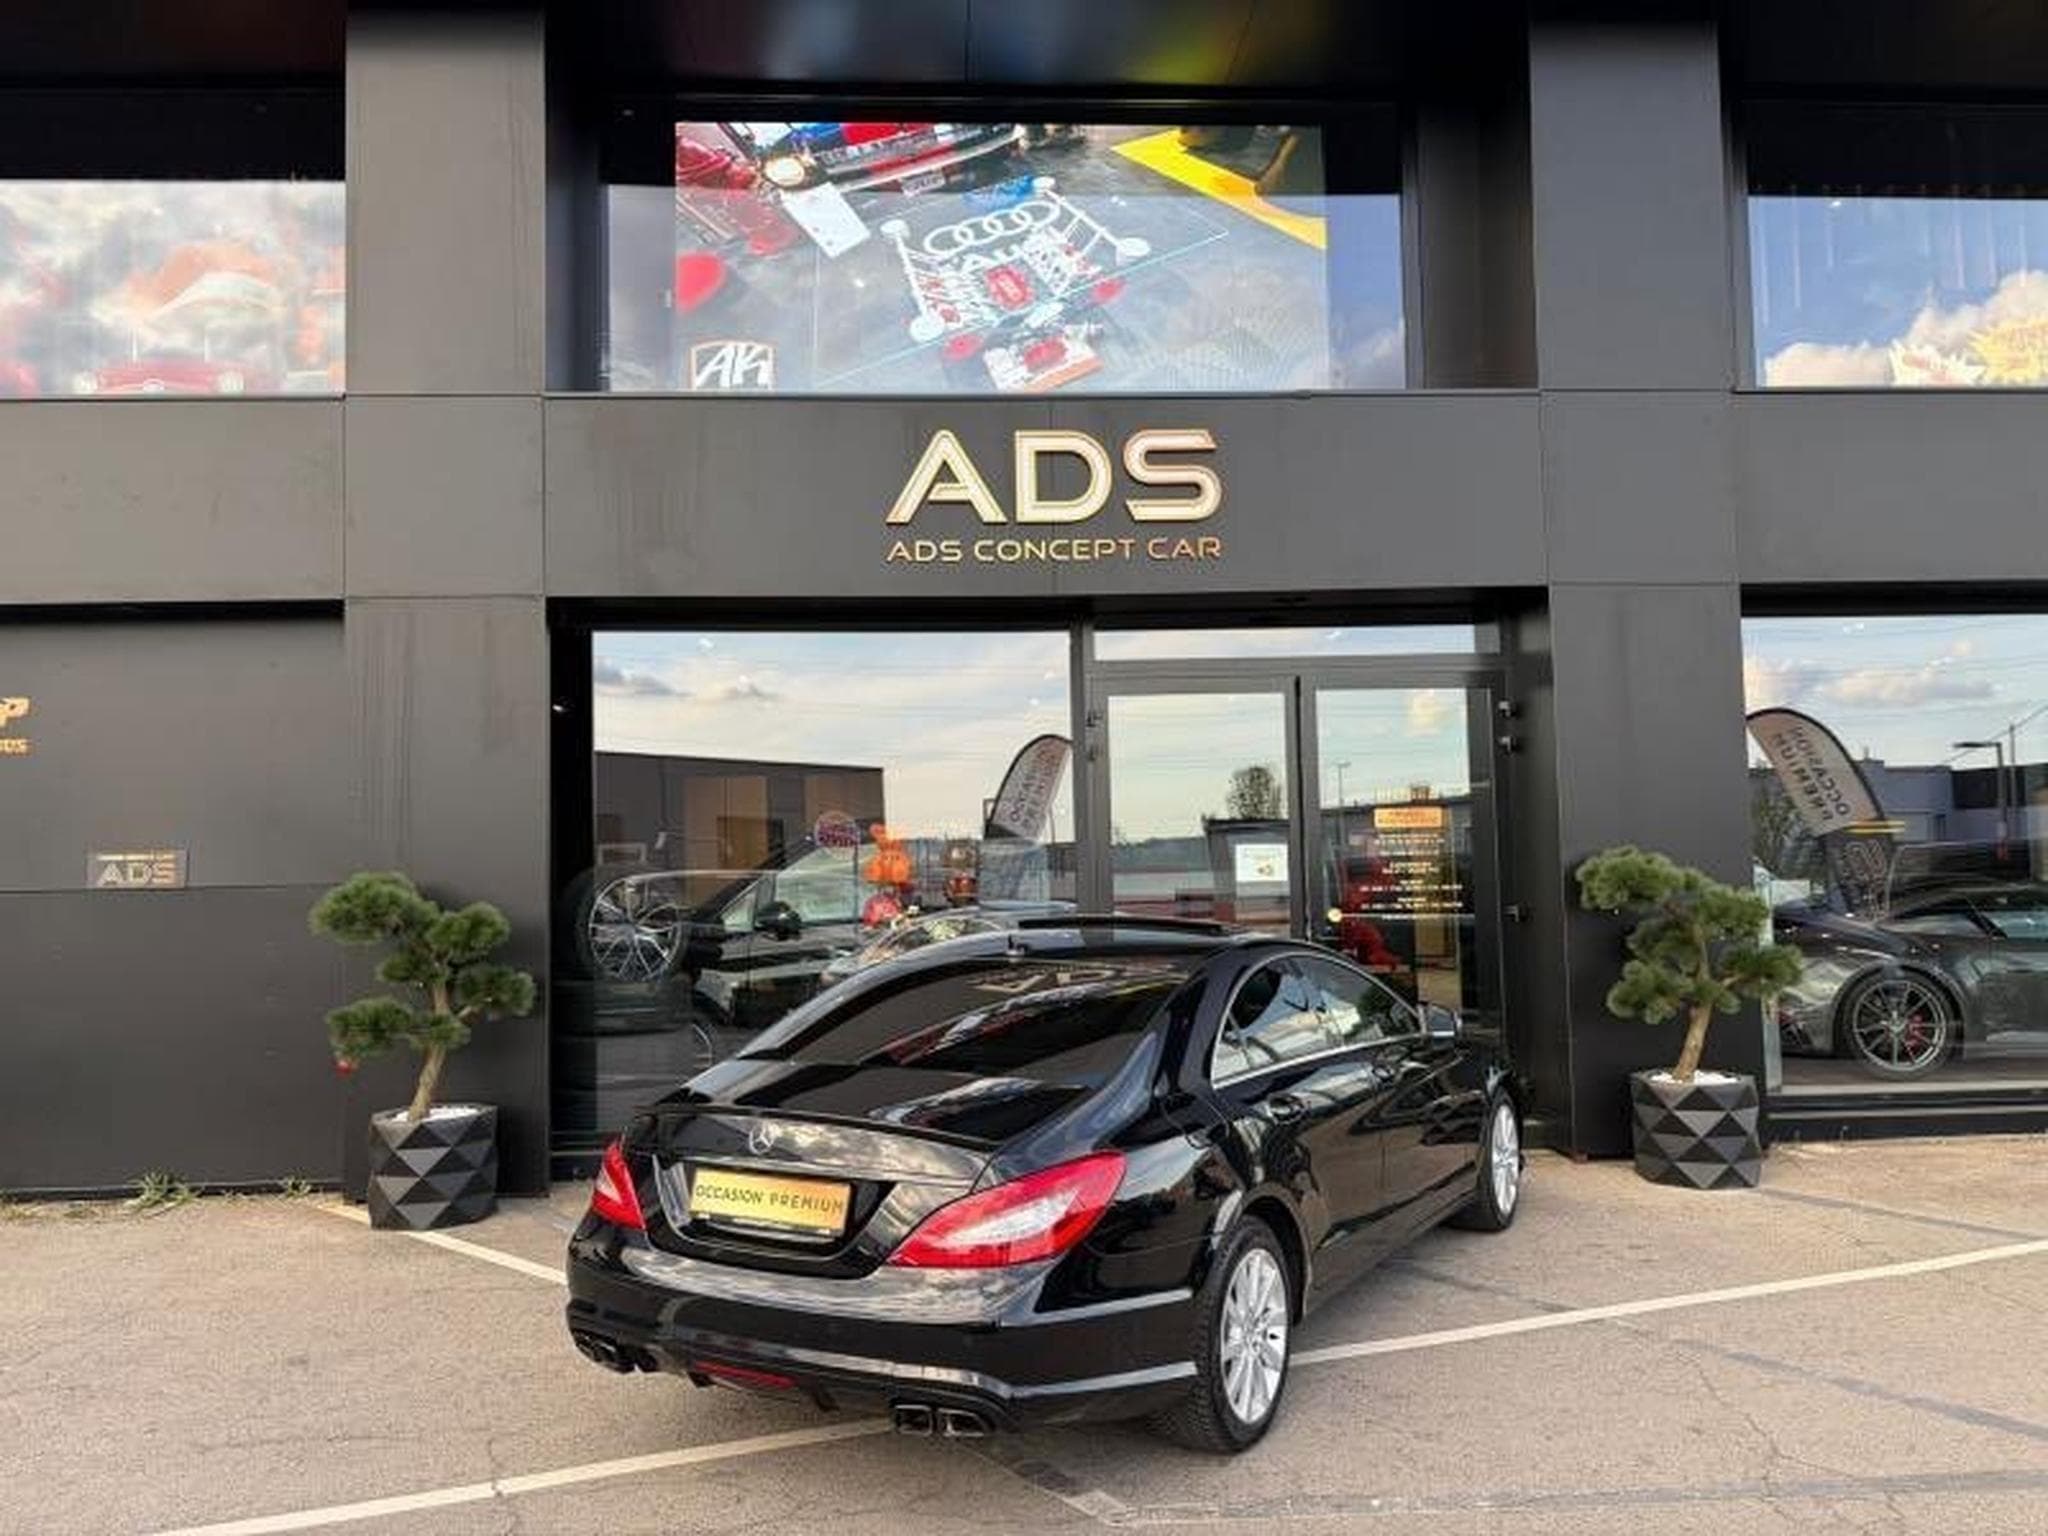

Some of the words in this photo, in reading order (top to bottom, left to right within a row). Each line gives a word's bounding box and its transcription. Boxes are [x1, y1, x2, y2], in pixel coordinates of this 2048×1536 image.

[885, 429, 1223, 524] ADS
[886, 540, 963, 563] ADS
[974, 538, 1136, 562] CONCEPT
[1147, 536, 1223, 561] CAR
[97, 860, 176, 888] ADS
[695, 1184, 765, 1205] OCCASION
[769, 1191, 844, 1215] PREMIUM
